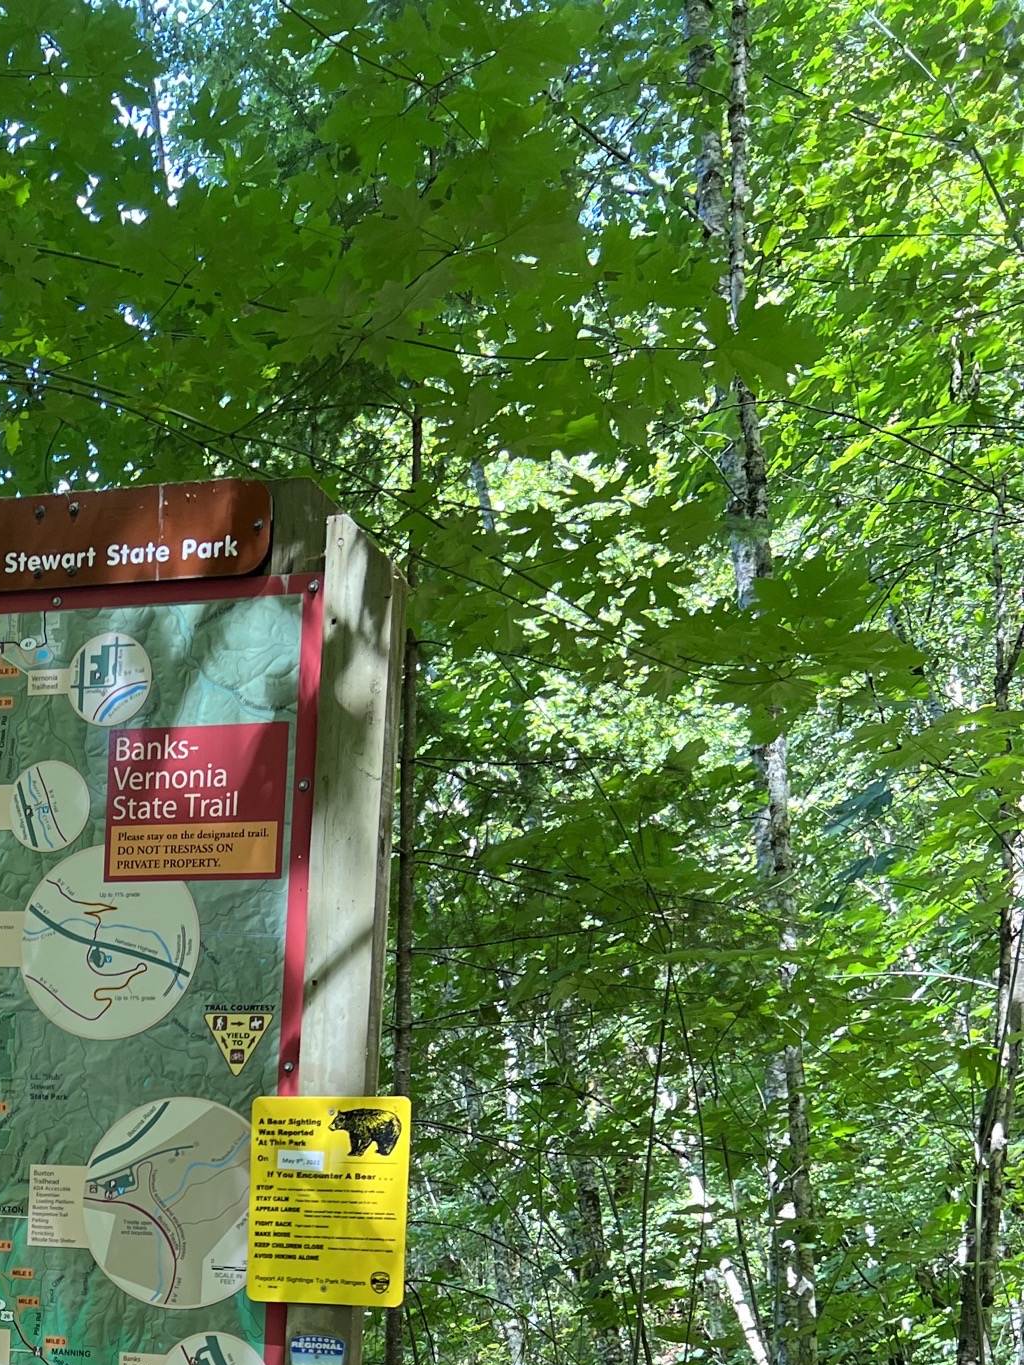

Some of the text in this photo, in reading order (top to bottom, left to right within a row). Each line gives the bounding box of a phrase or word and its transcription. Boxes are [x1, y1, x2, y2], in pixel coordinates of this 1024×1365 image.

[4, 547, 96, 573] Stewart
[107, 542, 170, 566] State
[181, 535, 237, 561] Park
[31, 683, 58, 691] Trailhead
[116, 732, 199, 761] Banks-
[114, 762, 227, 790] Vernonia
[112, 790, 238, 820] State Trail
[117, 831, 145, 841] Please
[146, 834, 164, 843] stay
[180, 830, 195, 840] the
[196, 828, 245, 842] designated
[247, 828, 269, 838] trail.
[117, 843, 234, 856] DO NOT TRESPASS ON
[117, 858, 221, 870] PRIVATE PROPERTY.
[230, 1004, 276, 1012] COURTESY
[288, 1118, 321, 1127] Sighting
[258, 1128, 314, 1138] Was Reported
[258, 1138, 306, 1147] At This Park
[257, 1154, 269, 1162] On
[33, 1169, 55, 1177] Buxton
[266, 1170, 274, 1178] If
[296, 1171, 343, 1180] Encounter
[344, 1172, 352, 1180] A
[354, 1172, 376, 1180] Bear
[33, 1177, 60, 1185] Trailhead
[271, 1242, 303, 1250] CHILDREN
[255, 1274, 276, 1282] Report
[286, 1276, 314, 1284] Sightings
[340, 1278, 366, 1287] Rangers
[291, 1340, 343, 1351] REGIONAL
[298, 1337, 335, 1345] OREGON
[50, 1347, 91, 1358] MANNING
[123, 1355, 141, 1363] Banks
